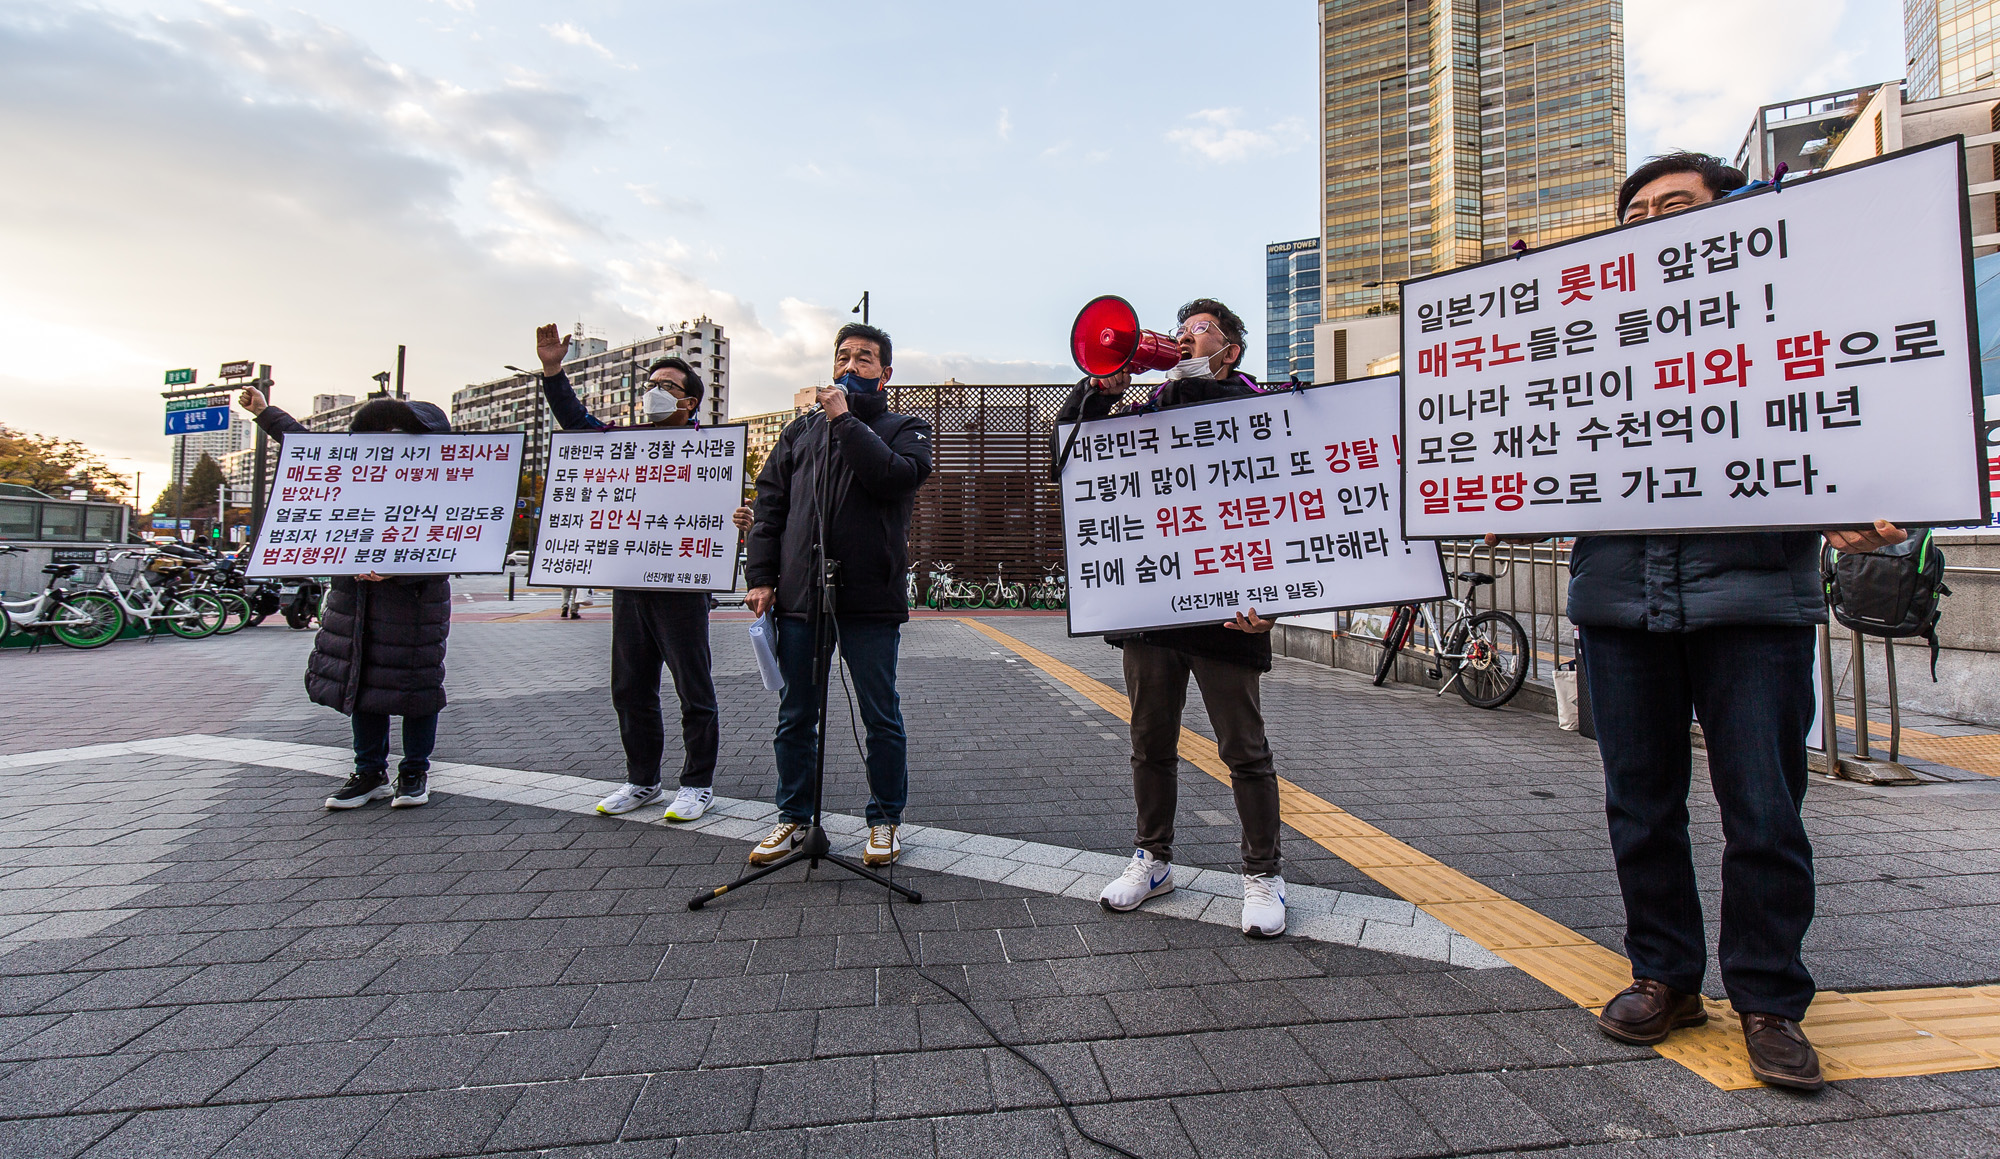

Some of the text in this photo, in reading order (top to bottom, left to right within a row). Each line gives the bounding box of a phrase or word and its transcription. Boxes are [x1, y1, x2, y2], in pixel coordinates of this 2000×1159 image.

[1268, 240, 1317, 253] WORLD TOWER
[1417, 219, 1787, 333] 일본기업 롯데 앞잡이
[1419, 317, 1597, 381] 매국노들은
[1615, 291, 1744, 349] 들어라
[1419, 320, 1945, 424] 이나라 국민이 피와 땀으로
[1418, 386, 1861, 464] 모은 재산 수천억이 매년
[1073, 427, 1159, 462] 대한민국
[1171, 417, 1239, 449] 노른자
[1249, 412, 1272, 440] 땅
[291, 444, 509, 461] 국내 최대 기업 사기 범죄사실
[559, 445, 604, 460] 대한민국
[681, 439, 735, 458] 수사관을
[287, 465, 474, 483] 매도용 인감 어떻게 발부
[555, 464, 732, 483] 모두 부실수사 범죄은폐 막이에
[1075, 471, 1140, 502] 그렇게
[1151, 464, 1196, 495] 많이
[1208, 456, 1279, 487] 가지고
[1291, 451, 1314, 476] 또
[1325, 438, 1379, 473] 강탈
[1420, 454, 1837, 514] 일본땅으로 가고 있다.
[282, 487, 341, 501] 받았나?
[553, 487, 636, 502] 동원 할 수 없다
[276, 508, 322, 522] 얼굴도
[328, 508, 376, 521] 모르는
[446, 506, 504, 521] 인감도용
[549, 513, 584, 528] 범죄자
[674, 514, 724, 530] 수사하라
[1077, 483, 1389, 547] 롯데는 위조 전문기업 인가
[269, 525, 482, 543] 범죄자 12년을 숨긴 롯데의
[263, 547, 456, 565] 범죄행위! 분명 밝혀진다
[545, 538, 724, 558] 이나라 국법을 무시하는 롯데는
[542, 558, 592, 574] 각성하라!
[1080, 558, 1124, 588] 뒤에
[1135, 552, 1181, 583] 숨어
[1194, 539, 1274, 575] 도적질
[1286, 528, 1389, 564] 그만해라
[644, 571, 711, 584] (선진개발 직원 일동)
[1171, 580, 1324, 613] (선진개발 직원 일동)
